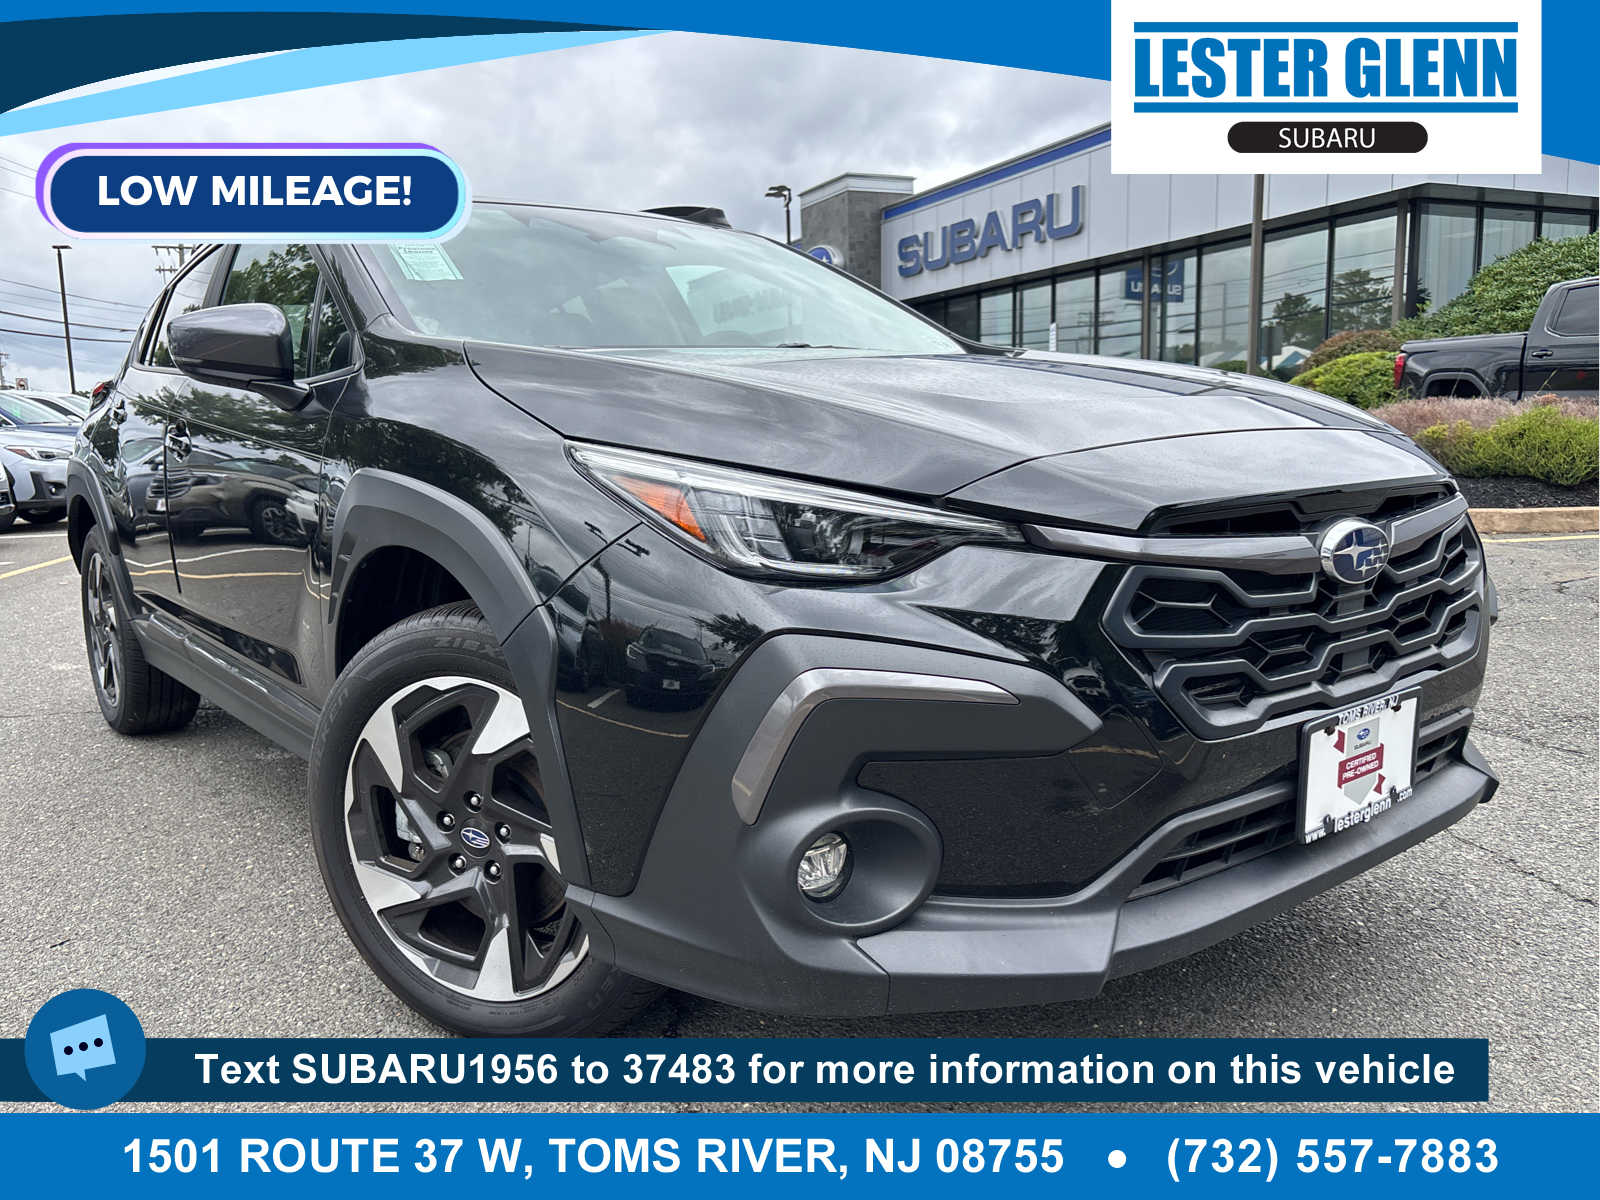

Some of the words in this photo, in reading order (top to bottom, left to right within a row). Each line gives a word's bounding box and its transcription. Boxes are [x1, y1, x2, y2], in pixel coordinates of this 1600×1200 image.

[897, 185, 1085, 278] SUBARU
[1339, 707, 1361, 725] TOMS
[1342, 760, 1379, 780] PRE-OWNED
[1345, 752, 1377, 770] CERTIFIED
[1333, 797, 1392, 833] lesterglenn
